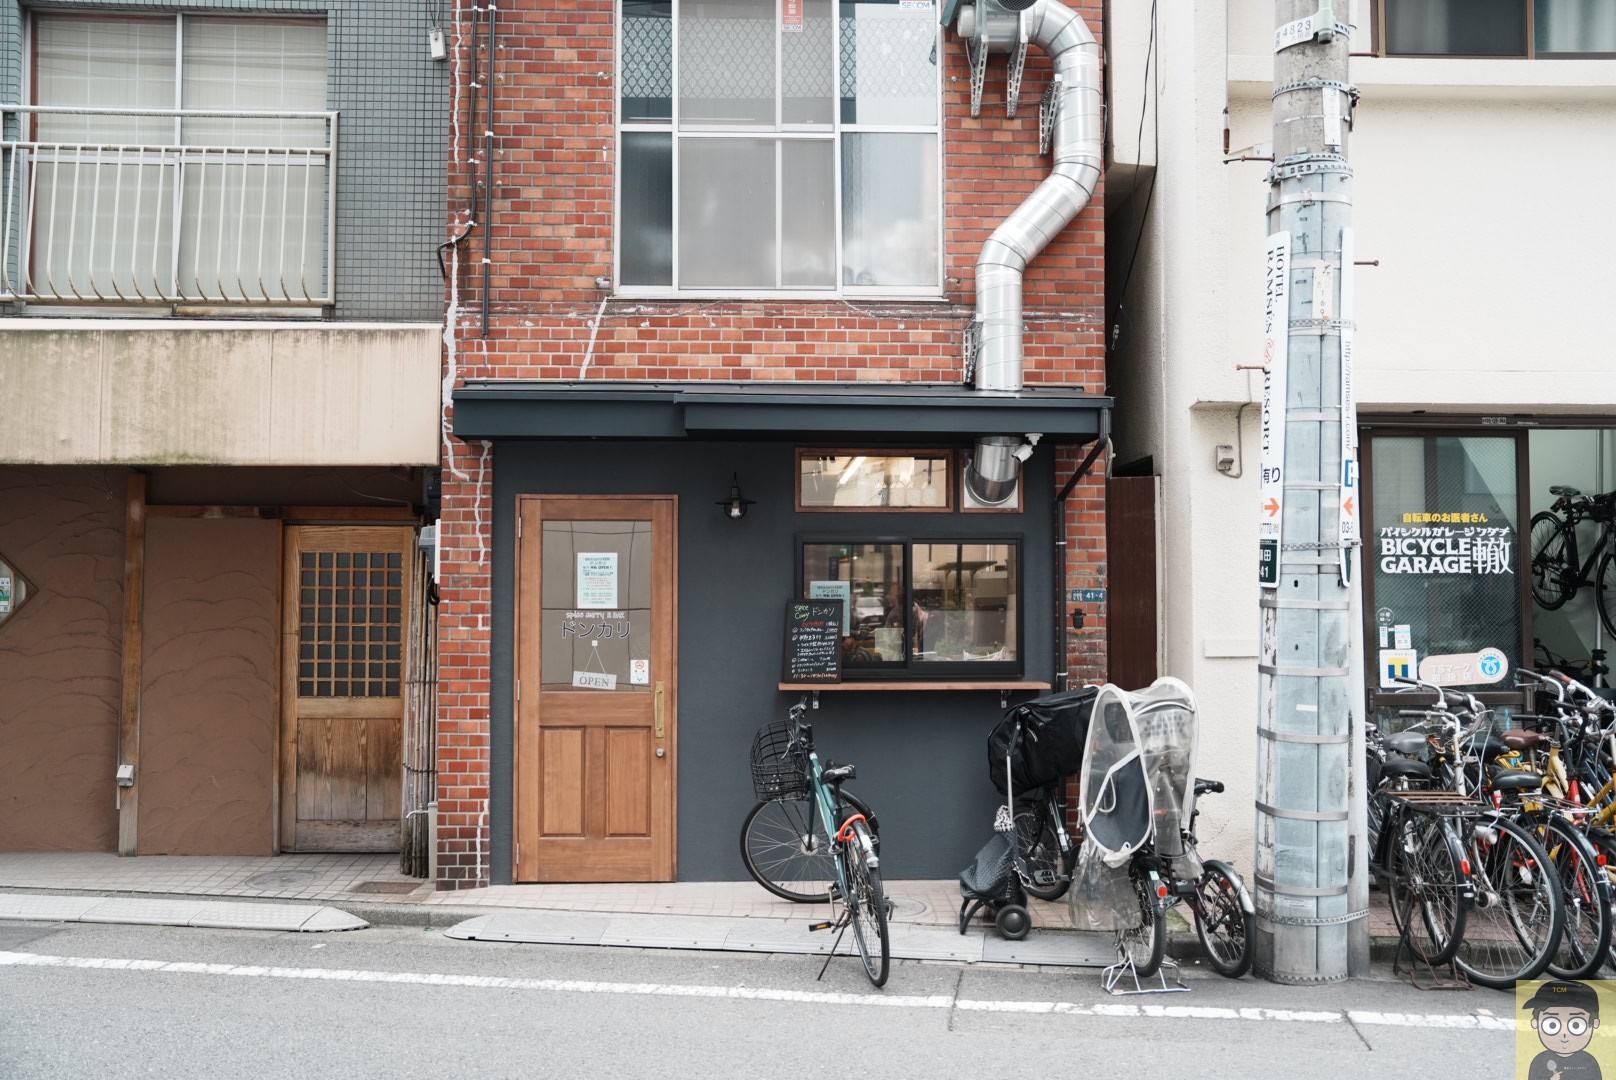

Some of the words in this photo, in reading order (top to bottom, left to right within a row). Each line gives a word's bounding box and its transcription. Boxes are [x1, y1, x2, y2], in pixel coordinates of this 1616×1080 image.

[901, 1, 930, 9] SECOM
[1283, 20, 1311, 37] 4823
[1275, 245, 1285, 303] HOTEL
[1263, 369, 1271, 456] RESORT
[1402, 512, 1489, 524] 自転車のお医者さん
[1380, 526, 1475, 538] バイシクルガレージ
[1476, 526, 1511, 537] ワダチ
[1380, 538, 1472, 556] BICYCLE
[1472, 537, 1515, 575] 轍
[1380, 556, 1472, 574] GARAGE
[562, 620, 631, 639] ドンカリ
[1431, 663, 1472, 674] TSマーク
[579, 676, 610, 688] OPEN
